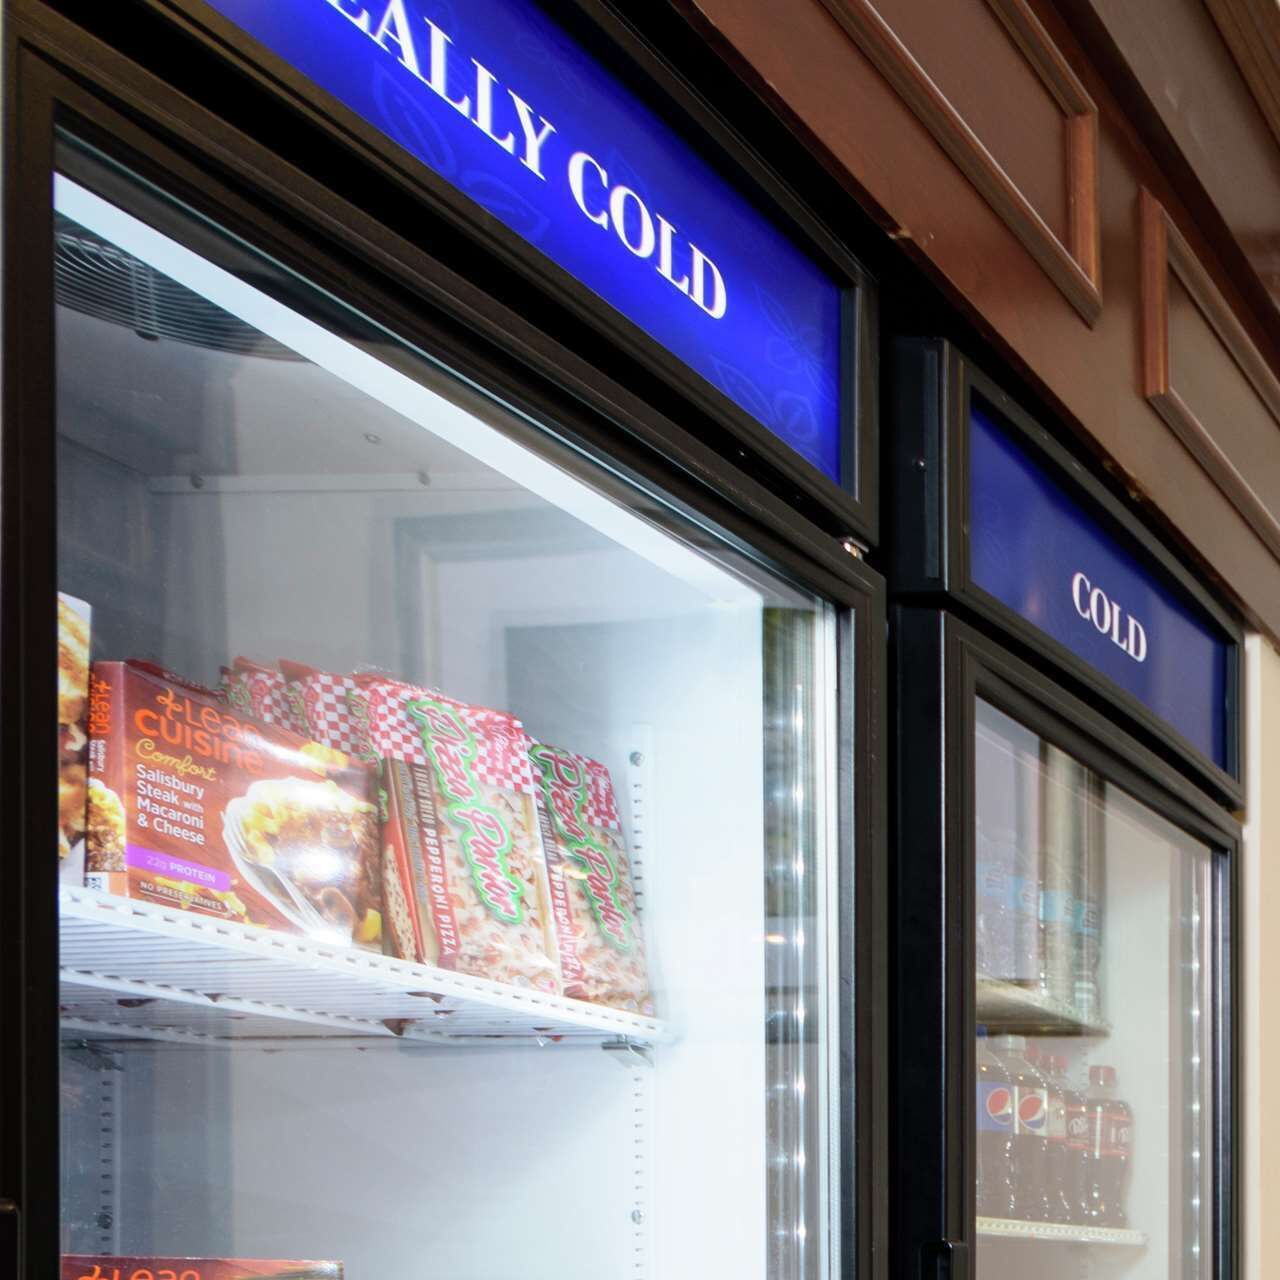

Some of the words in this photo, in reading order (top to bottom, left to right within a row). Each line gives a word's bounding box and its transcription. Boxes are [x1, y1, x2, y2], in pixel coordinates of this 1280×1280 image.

[326, 0, 557, 181] ALLY
[568, 151, 728, 319] COLD
[1072, 572, 1147, 663] COLD
[136, 764, 205, 799] Salisbury
[136, 780, 179, 805] Steak
[136, 797, 205, 828] Macaroni
[136, 813, 149, 828] &
[153, 817, 206, 845] Cheese
[169, 861, 217, 885] PROTEIN
